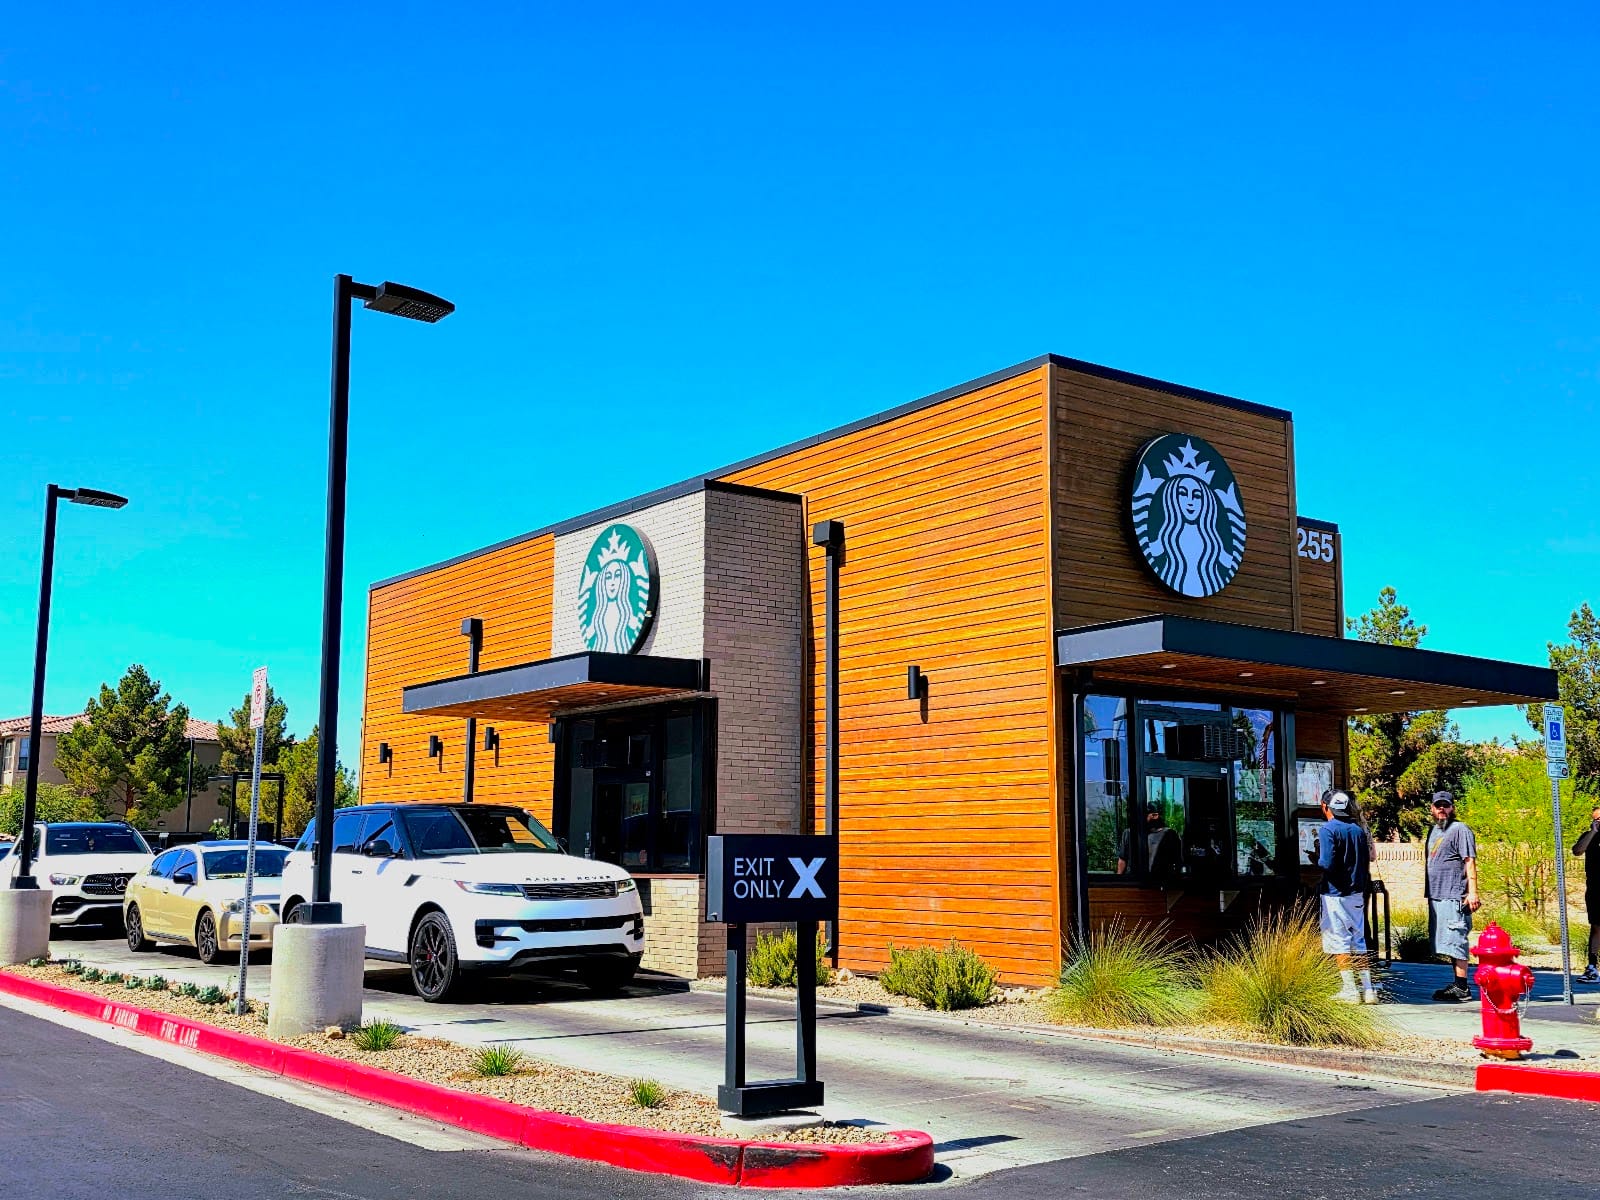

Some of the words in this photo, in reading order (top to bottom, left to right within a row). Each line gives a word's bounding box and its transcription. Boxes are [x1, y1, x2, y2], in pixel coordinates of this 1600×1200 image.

[1297, 528, 1334, 562] 255
[734, 857, 775, 876] EXIT
[733, 879, 785, 899] ONLY
[102, 1005, 112, 1020] NO
[114, 1007, 139, 1029] PARKING
[160, 1020, 178, 1041] FIRE
[179, 1027, 200, 1048] LANE
